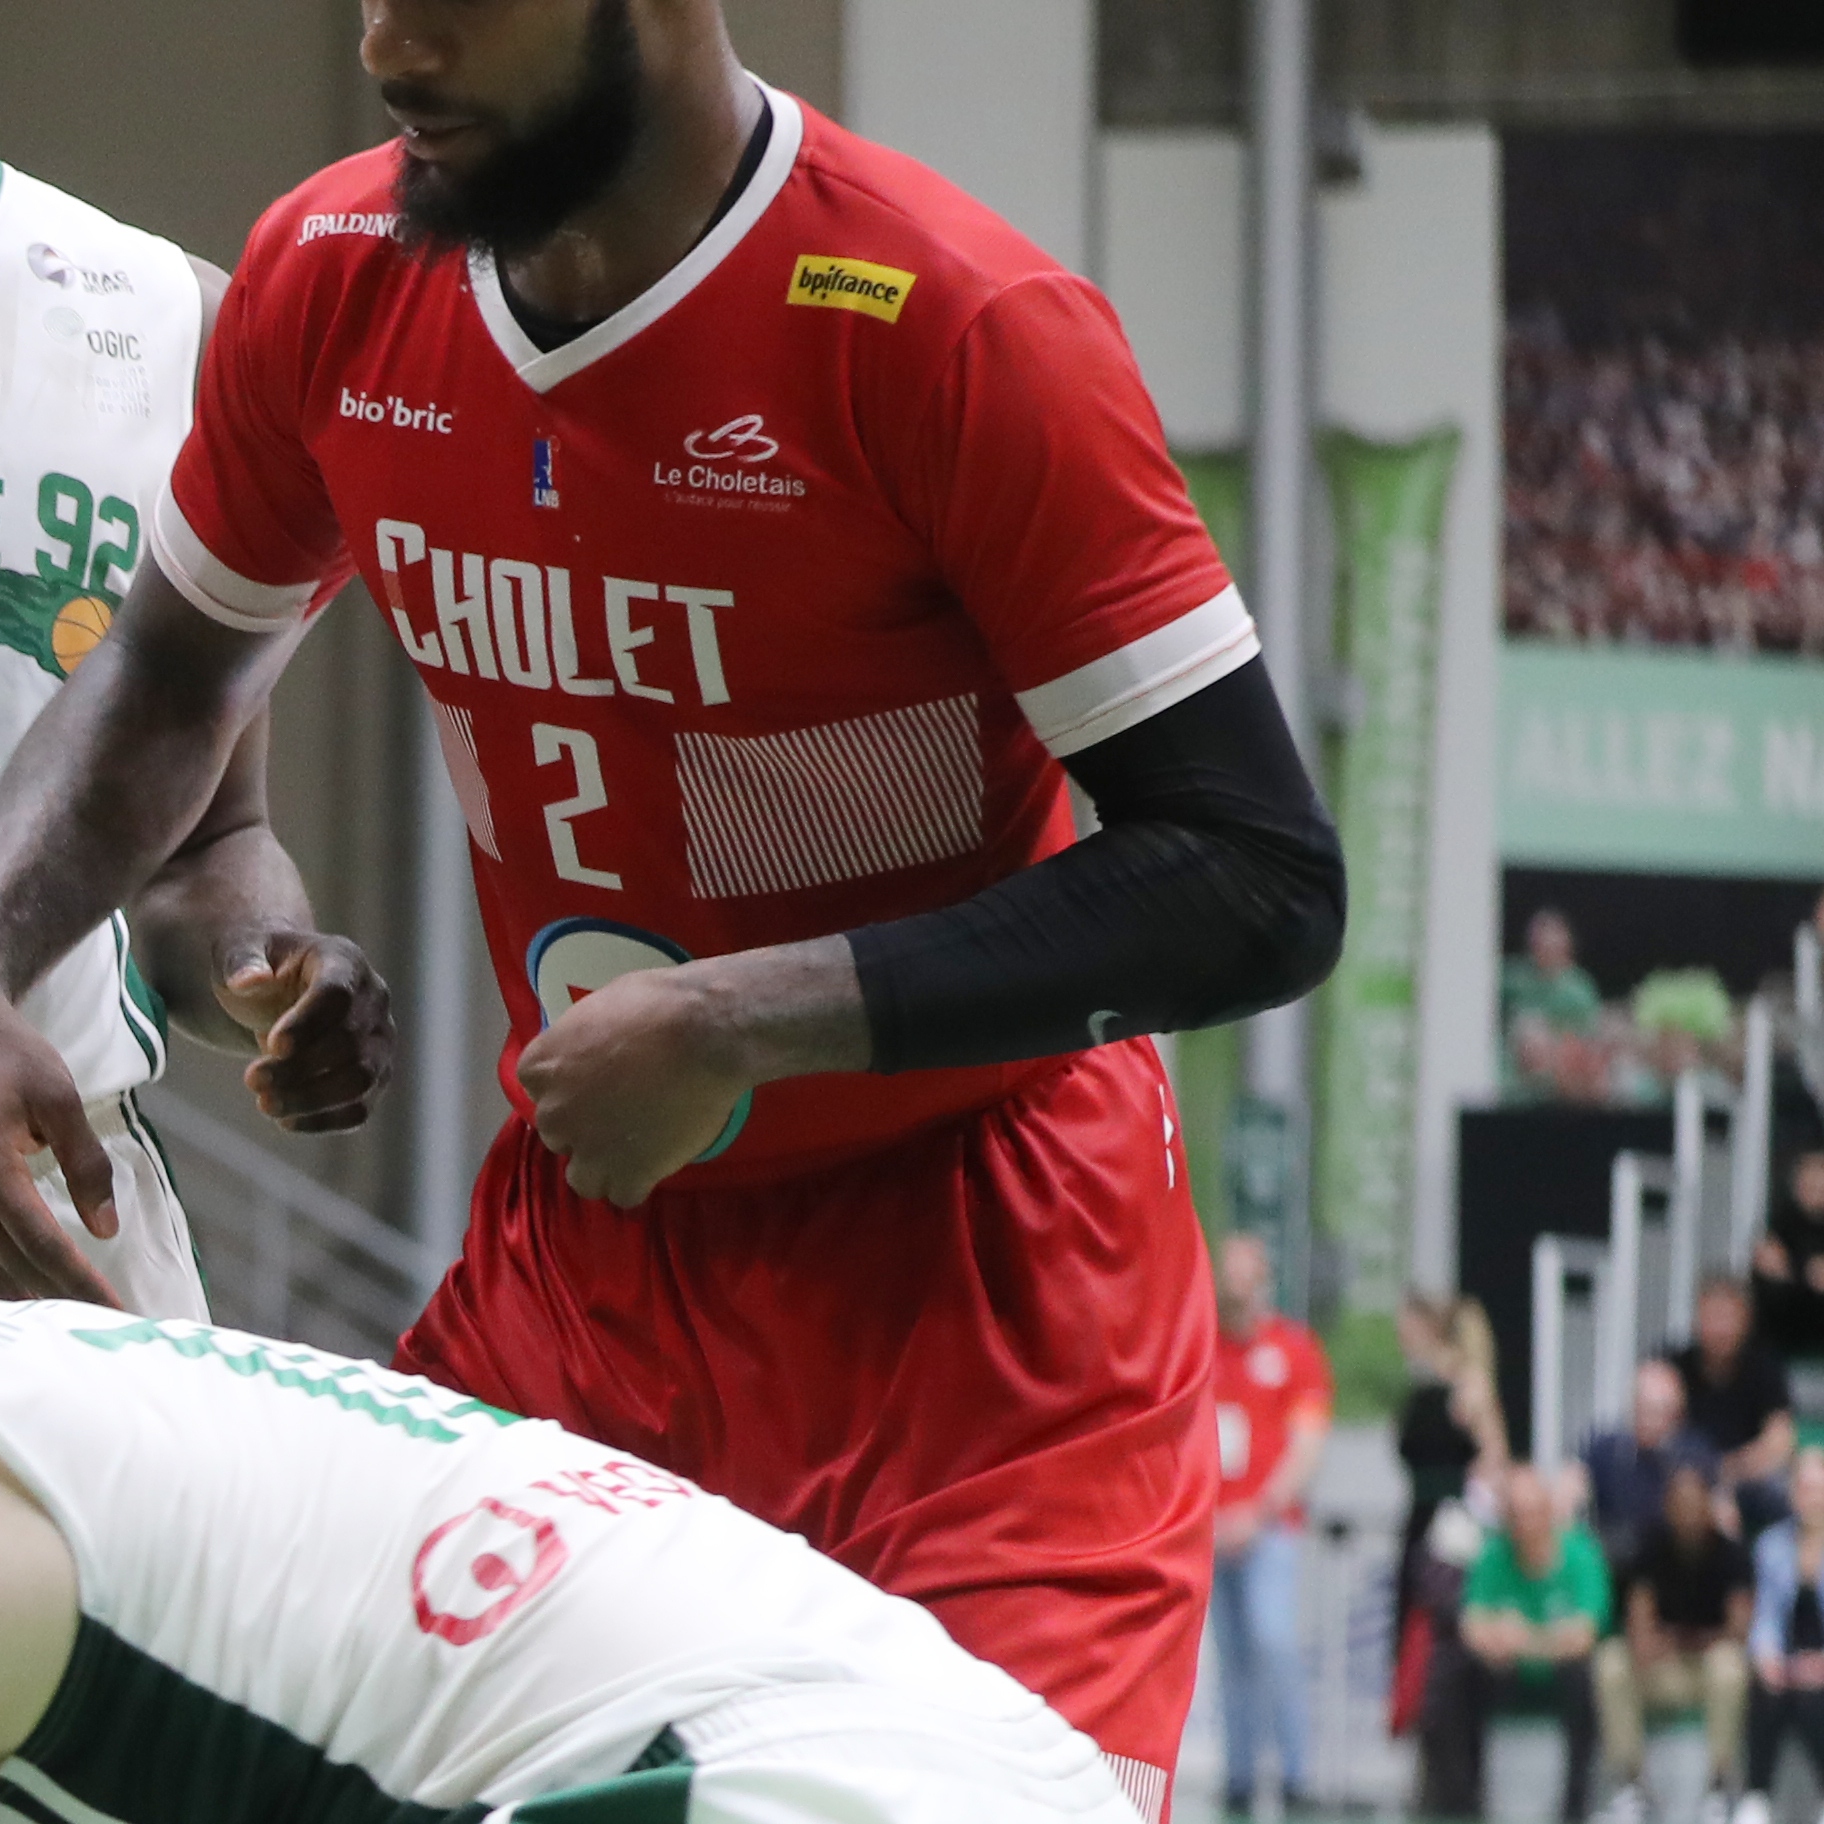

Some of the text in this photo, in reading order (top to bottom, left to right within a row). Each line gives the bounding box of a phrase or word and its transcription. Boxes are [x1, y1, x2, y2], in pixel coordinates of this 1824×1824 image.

[798, 264, 899, 304] bpifrance
[87, 330, 142, 361] OGIC
[339, 387, 453, 435] bio'bric
[653, 461, 806, 497] Le Choletais
[34, 472, 141, 594] 92
[374, 516, 736, 708] CHOLET
[531, 721, 623, 890] 2
